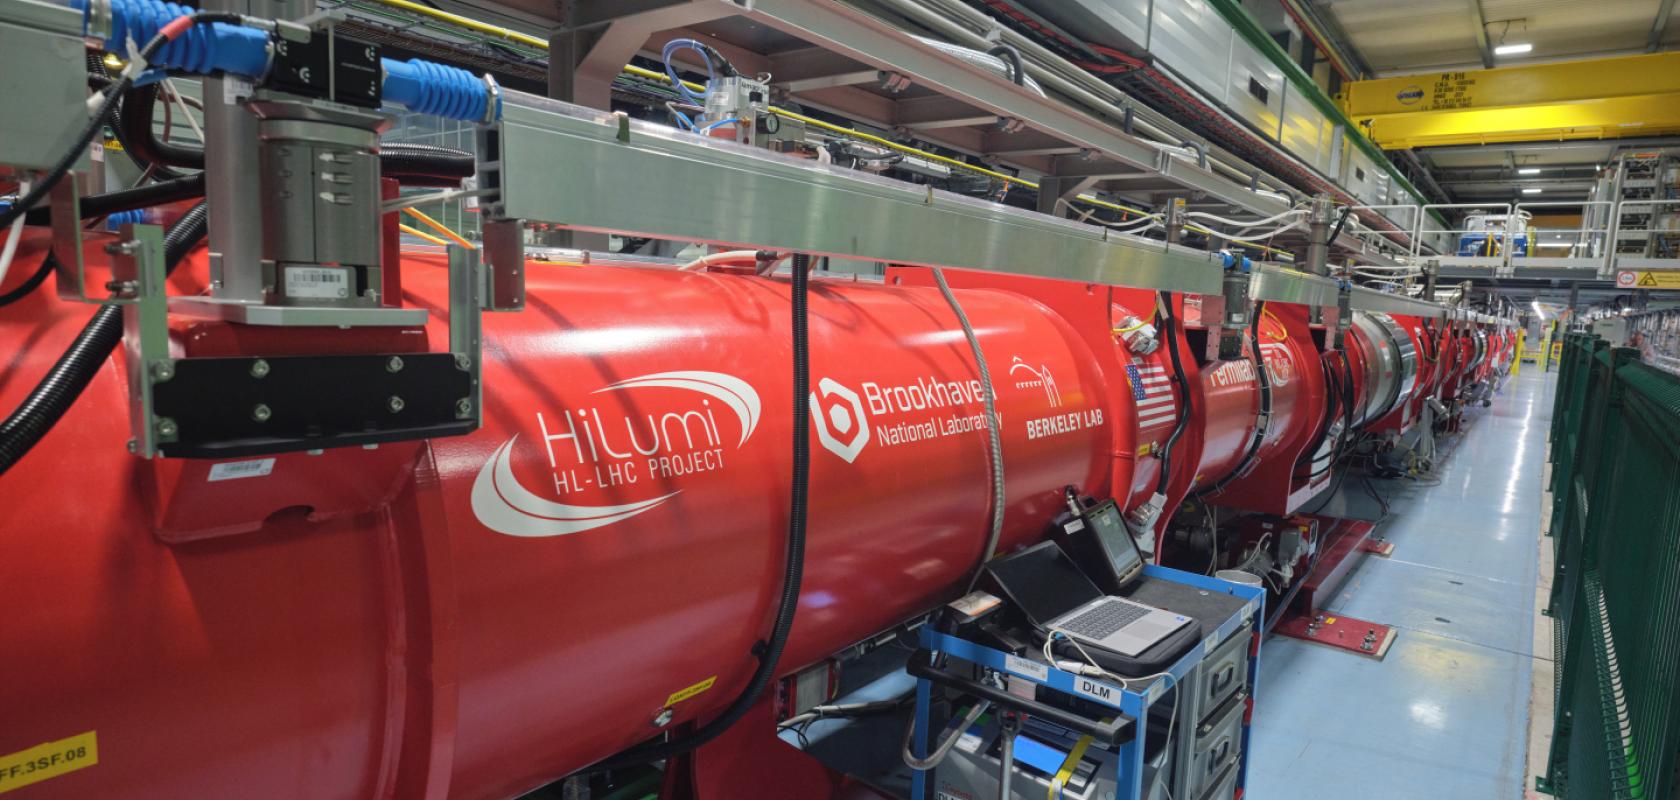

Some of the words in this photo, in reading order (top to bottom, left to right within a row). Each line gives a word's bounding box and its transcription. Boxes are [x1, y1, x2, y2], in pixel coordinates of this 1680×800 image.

[862, 376, 997, 415] Brookhave
[537, 399, 721, 468] HiLumi
[876, 417, 938, 447] National
[938, 411, 1003, 437] Laboraty
[1026, 412, 1081, 440] BERKELEY
[1084, 408, 1103, 428] LAB
[553, 461, 637, 496] HL-LHC
[648, 448, 723, 481] PROJECT
[1083, 681, 1111, 700] DLM
[0, 746, 86, 781] FF.3SF.08
